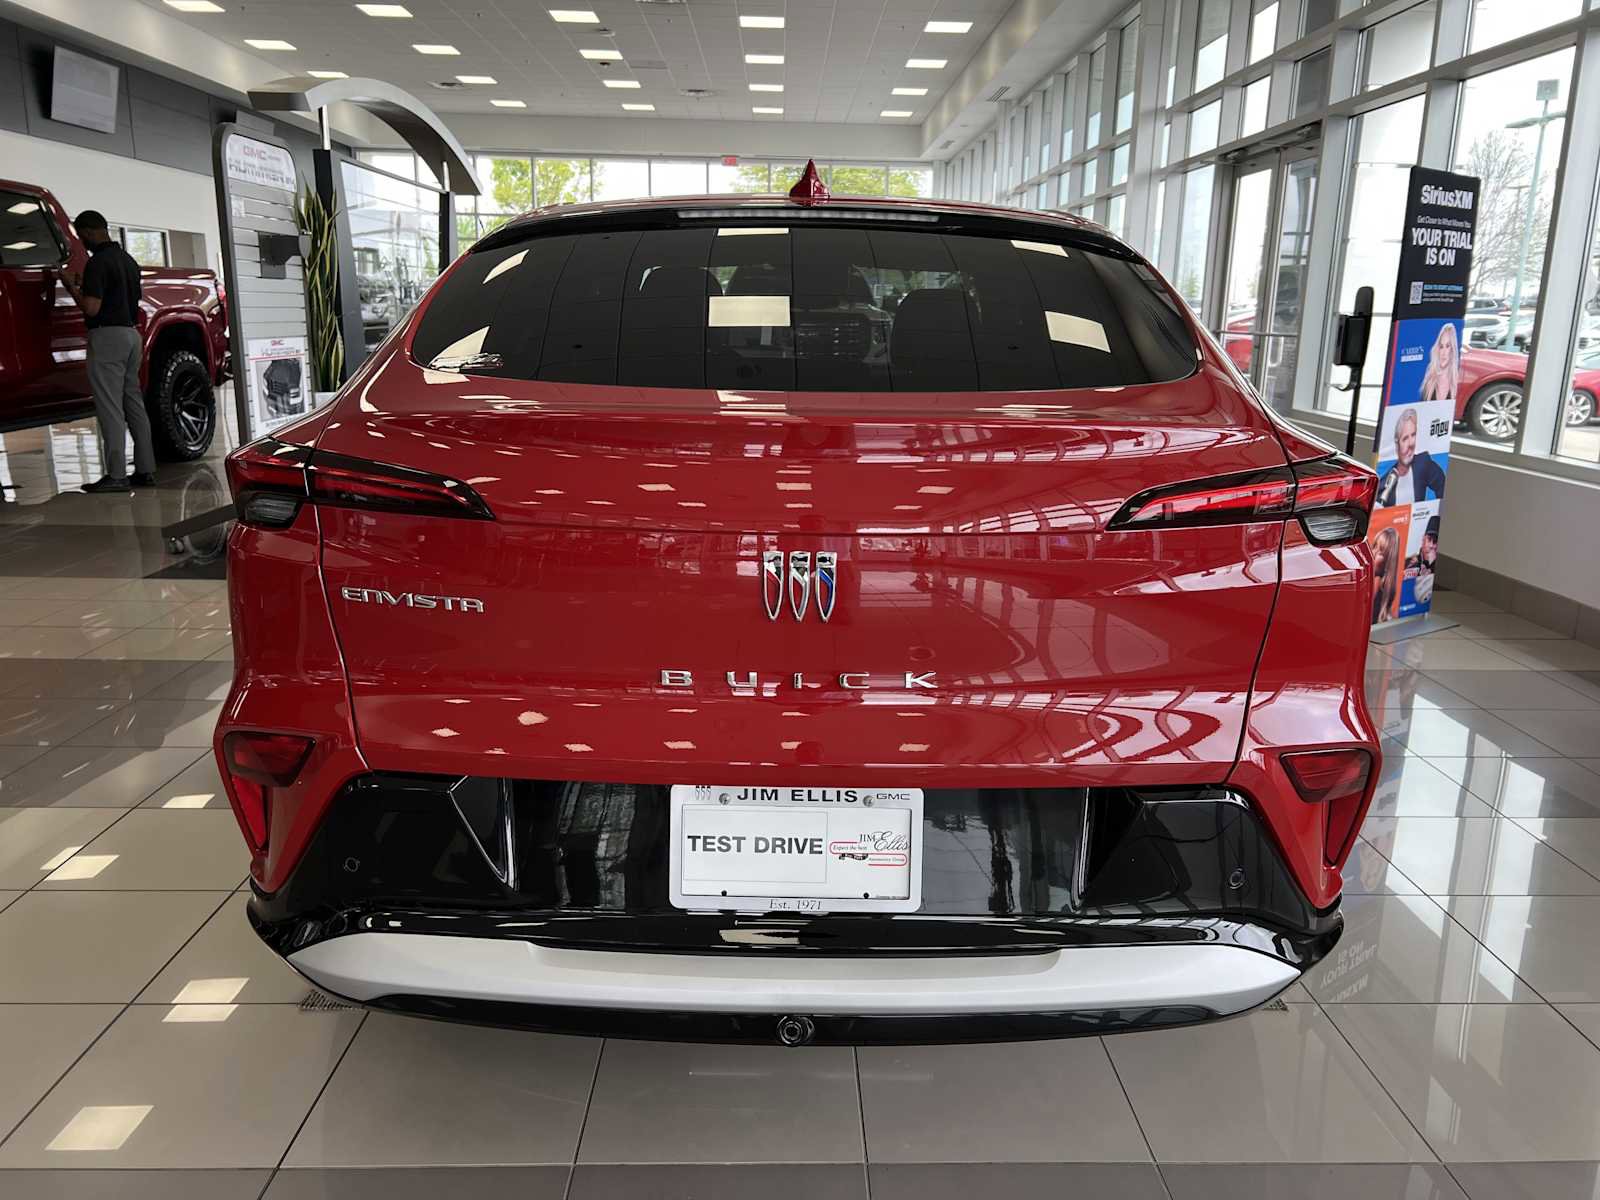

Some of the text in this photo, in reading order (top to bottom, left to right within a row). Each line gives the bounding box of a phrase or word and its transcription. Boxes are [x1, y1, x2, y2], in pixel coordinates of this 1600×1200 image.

[1421, 184, 1473, 209] SiriusXM
[1412, 227, 1473, 250] YOUR TRIAL
[1425, 247, 1456, 266] IS ON
[341, 586, 484, 613] ENVISTA
[661, 669, 938, 689] BUICK
[737, 788, 858, 803] JIM ELLIS
[876, 793, 911, 801] GMC
[687, 835, 824, 855] TEST DRIVE
[859, 831, 908, 851] JIM Ellis
[770, 899, 821, 911] Est. 1971
